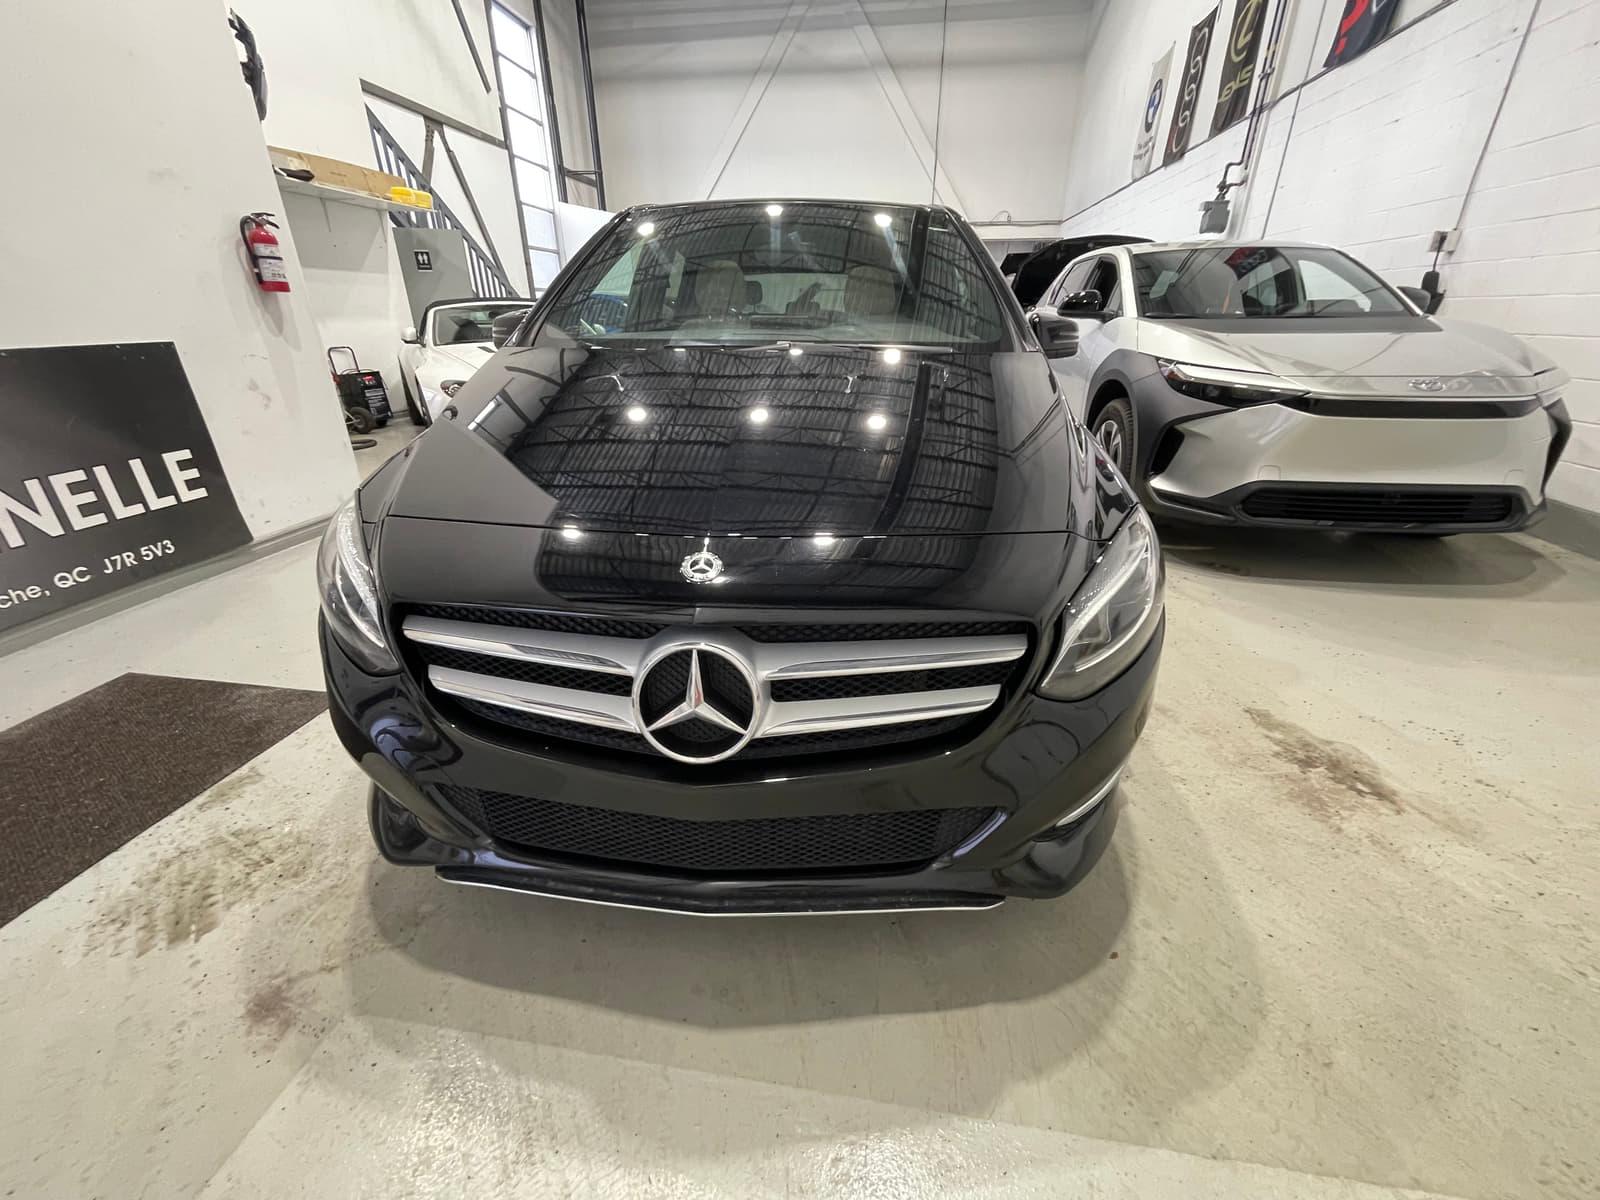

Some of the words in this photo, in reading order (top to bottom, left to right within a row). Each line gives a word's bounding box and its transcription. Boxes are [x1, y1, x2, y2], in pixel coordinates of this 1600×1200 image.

[0, 449, 208, 549] NELLE
[53, 566, 92, 588] QC
[103, 552, 138, 574] J7R
[140, 539, 175, 561] 5V3
